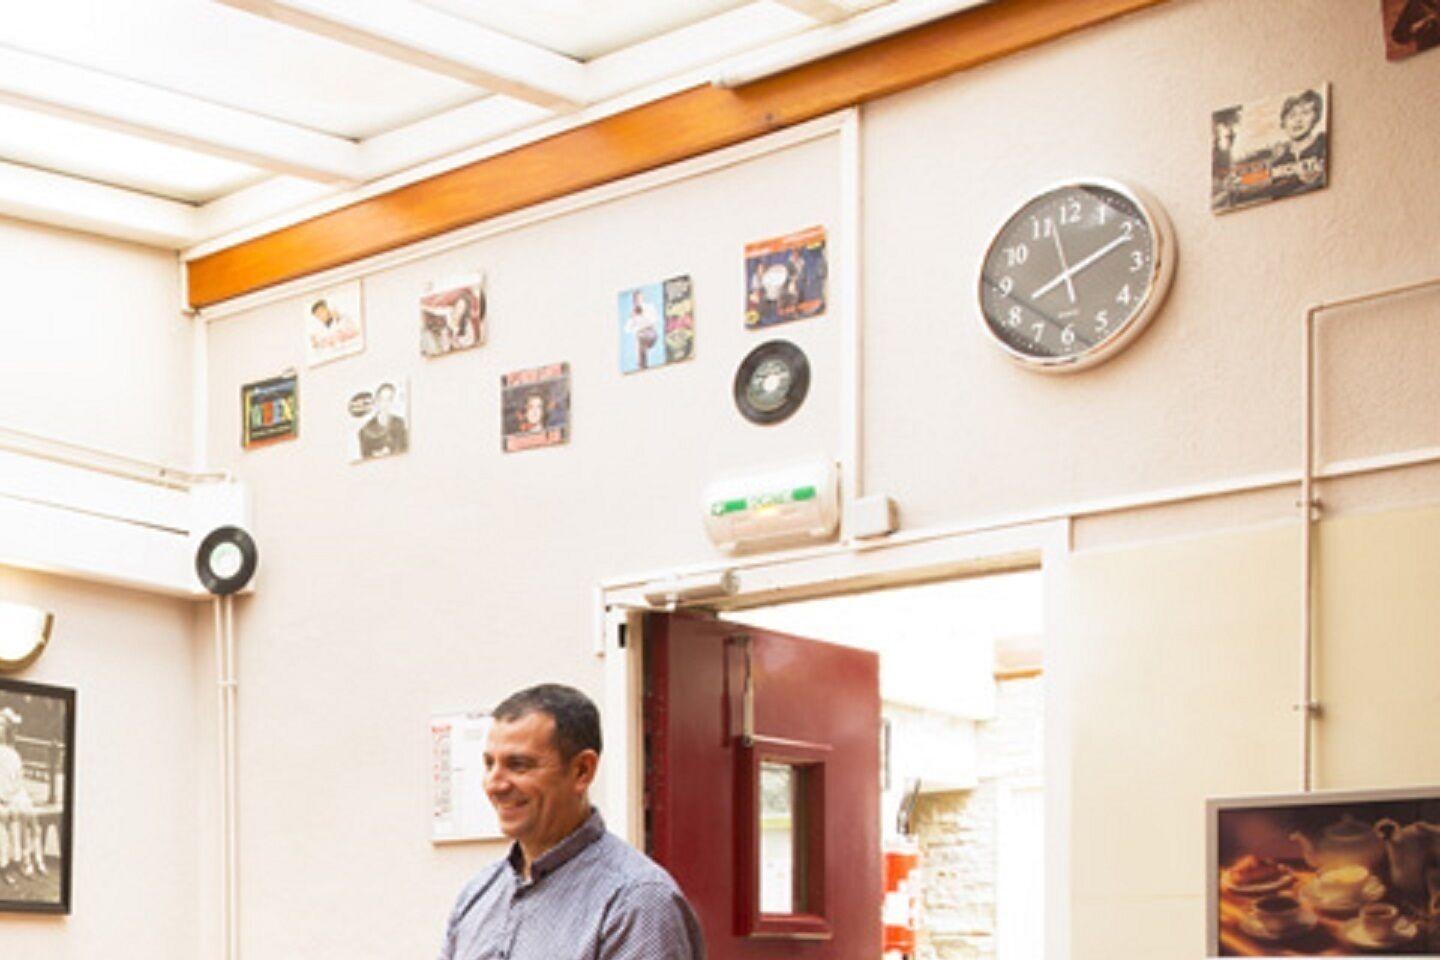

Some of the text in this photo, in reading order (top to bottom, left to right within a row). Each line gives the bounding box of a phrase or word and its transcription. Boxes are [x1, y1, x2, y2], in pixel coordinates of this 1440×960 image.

[1060, 203, 1081, 225] 12
[1096, 205, 1106, 224] 1
[1032, 216, 1053, 240] 11
[1120, 221, 1134, 240] 2
[1002, 243, 1028, 266] 10
[1129, 251, 1142, 272] 3
[999, 276, 1013, 296] 9
[1116, 285, 1130, 304] 4
[1009, 306, 1022, 327] 8
[1095, 310, 1108, 332] 5
[1032, 322, 1045, 343] 7
[1061, 324, 1075, 344] 6
